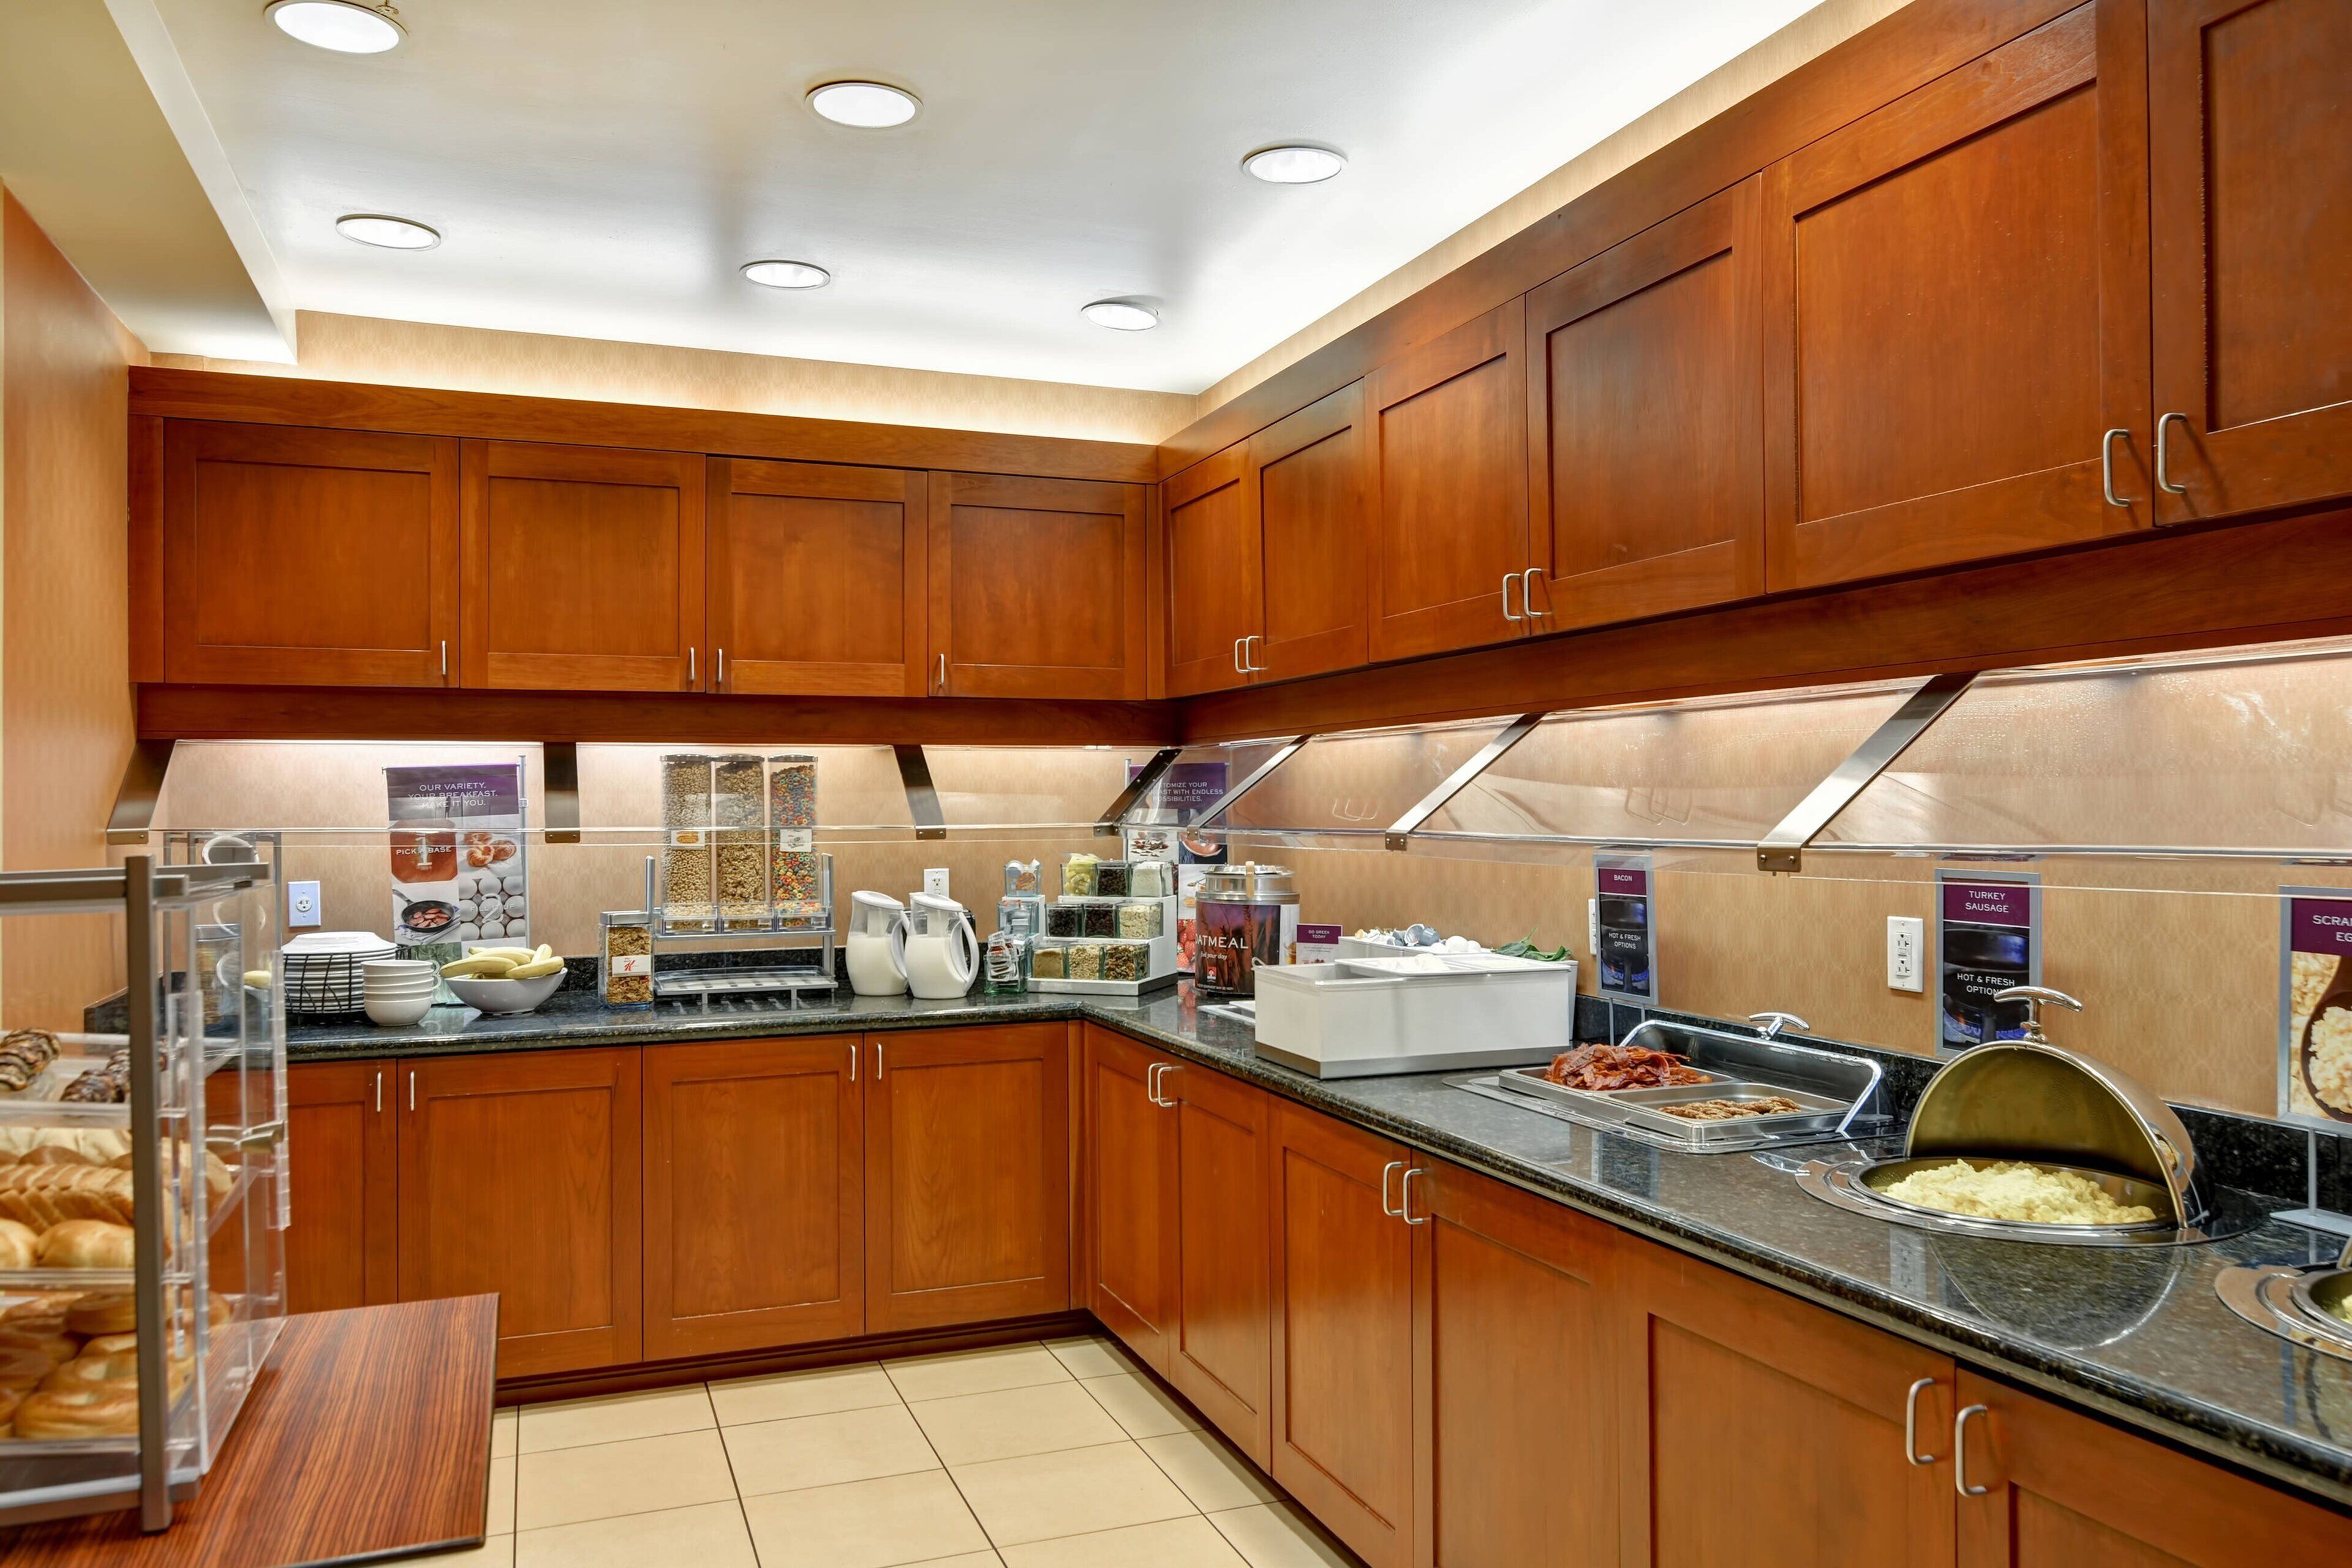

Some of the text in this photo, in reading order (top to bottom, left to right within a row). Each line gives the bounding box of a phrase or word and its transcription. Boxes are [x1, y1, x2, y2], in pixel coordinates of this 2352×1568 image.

[439, 790, 497, 799] BREAKFAST.
[1969, 891, 2006, 900] TURKEY
[481, 892, 503, 924] 2
[1965, 902, 2009, 913] SAUSAGE
[2313, 915, 2352, 927] SCRA
[1957, 973, 1975, 981] HOT
[1985, 976, 2015, 986] FRESH
[1966, 985, 2003, 995] OPTION
